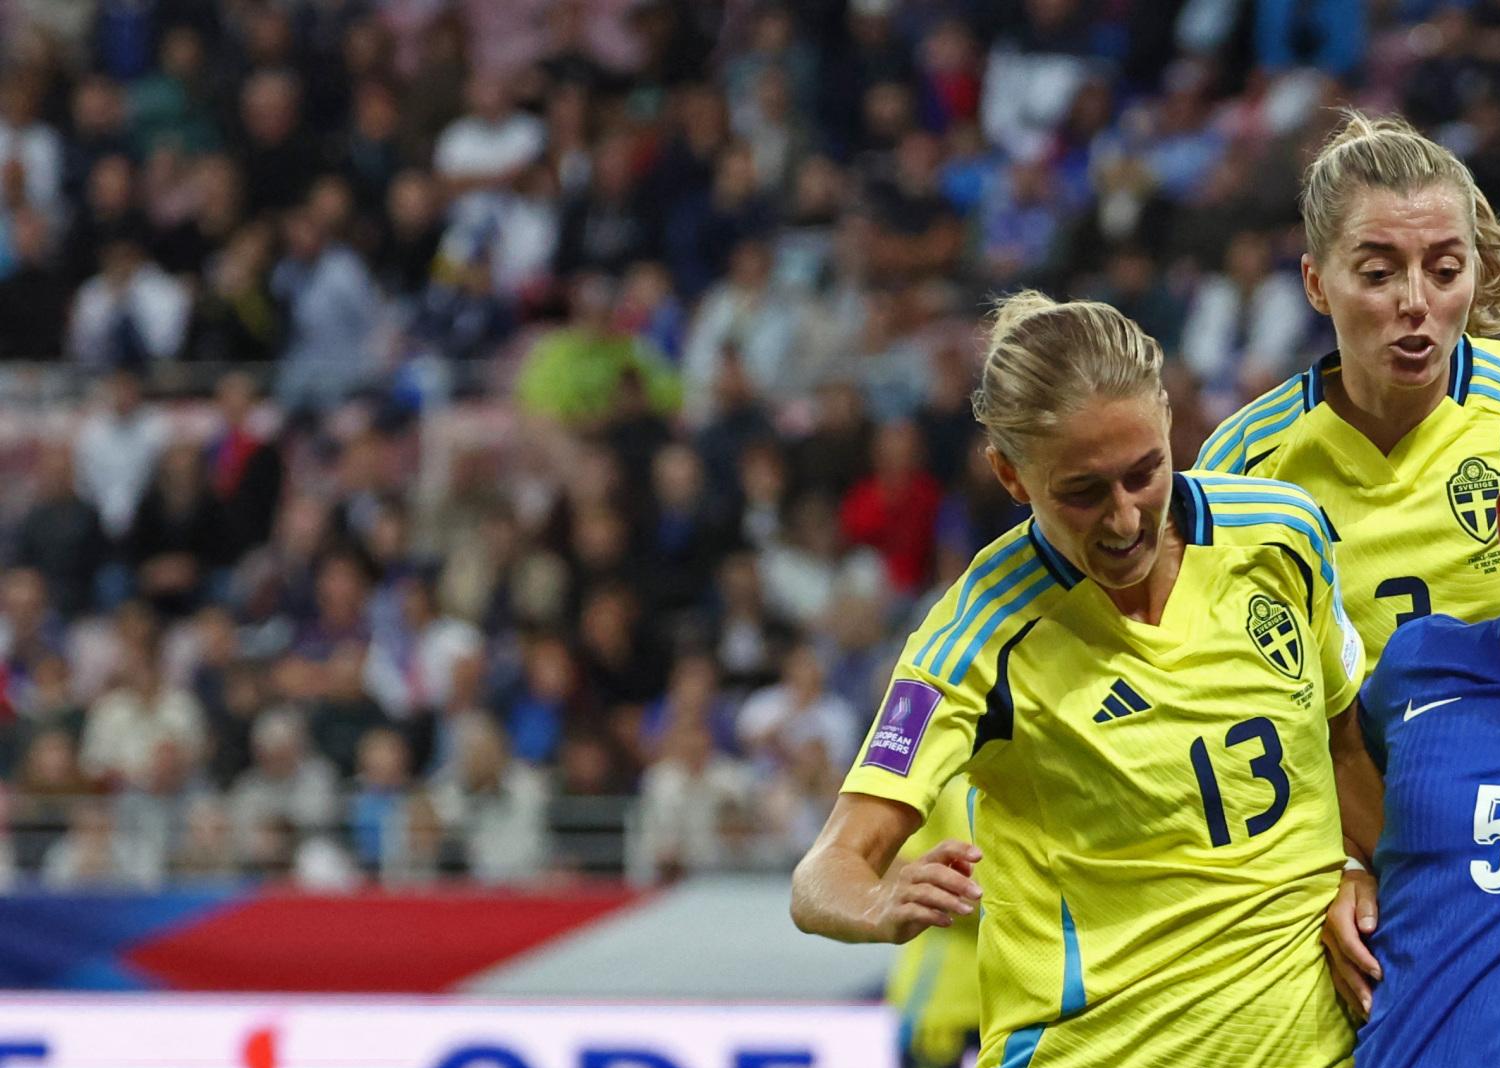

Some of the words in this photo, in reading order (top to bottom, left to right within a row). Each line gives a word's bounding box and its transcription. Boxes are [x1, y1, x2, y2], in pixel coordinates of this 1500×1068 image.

[1457, 480, 1494, 492] SVERIGE
[1256, 614, 1284, 635] SVERIGE
[1190, 717, 1291, 847] 13
